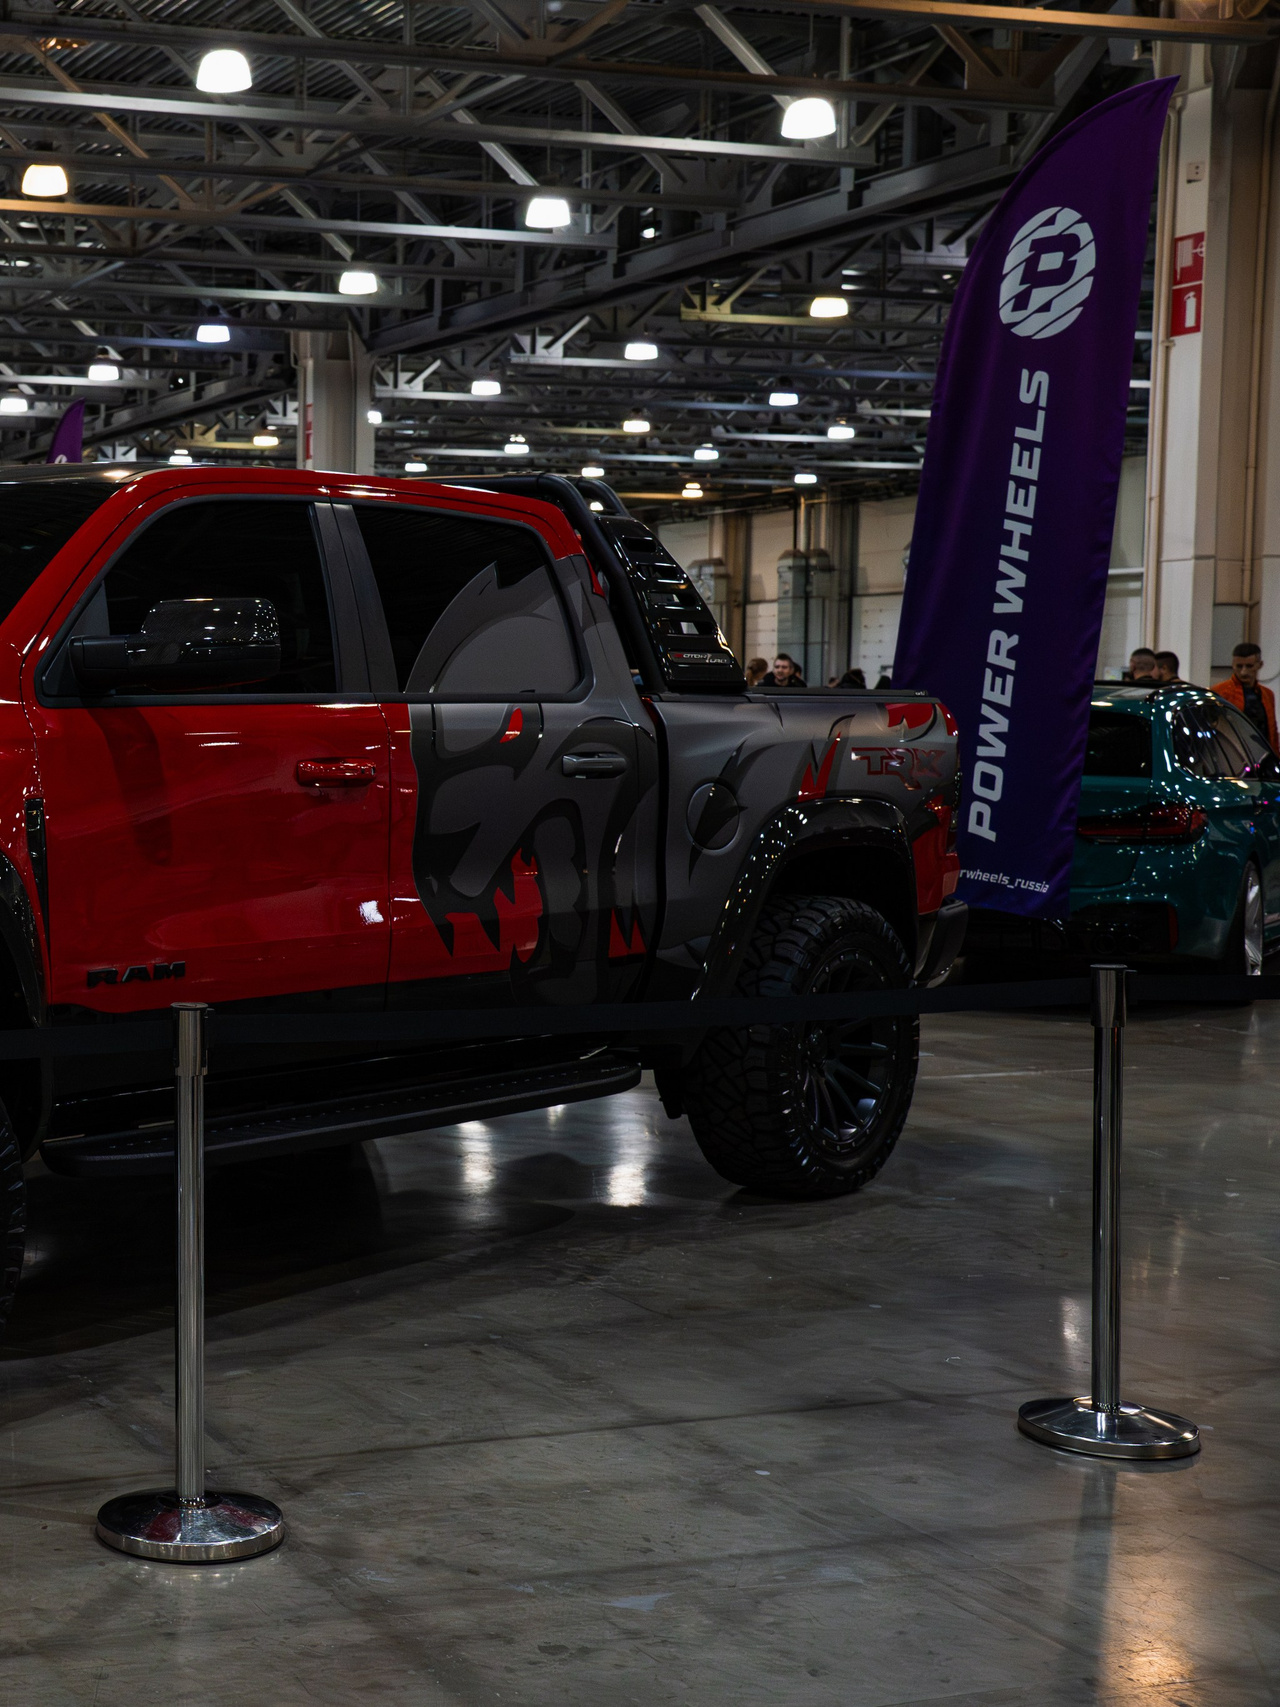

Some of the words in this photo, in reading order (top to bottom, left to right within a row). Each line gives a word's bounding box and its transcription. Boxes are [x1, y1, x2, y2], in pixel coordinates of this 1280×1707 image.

[992, 367, 1050, 614] WHEELS
[851, 747, 946, 791] TRX
[967, 629, 1020, 843] POWER
[87, 961, 186, 988] RAM
